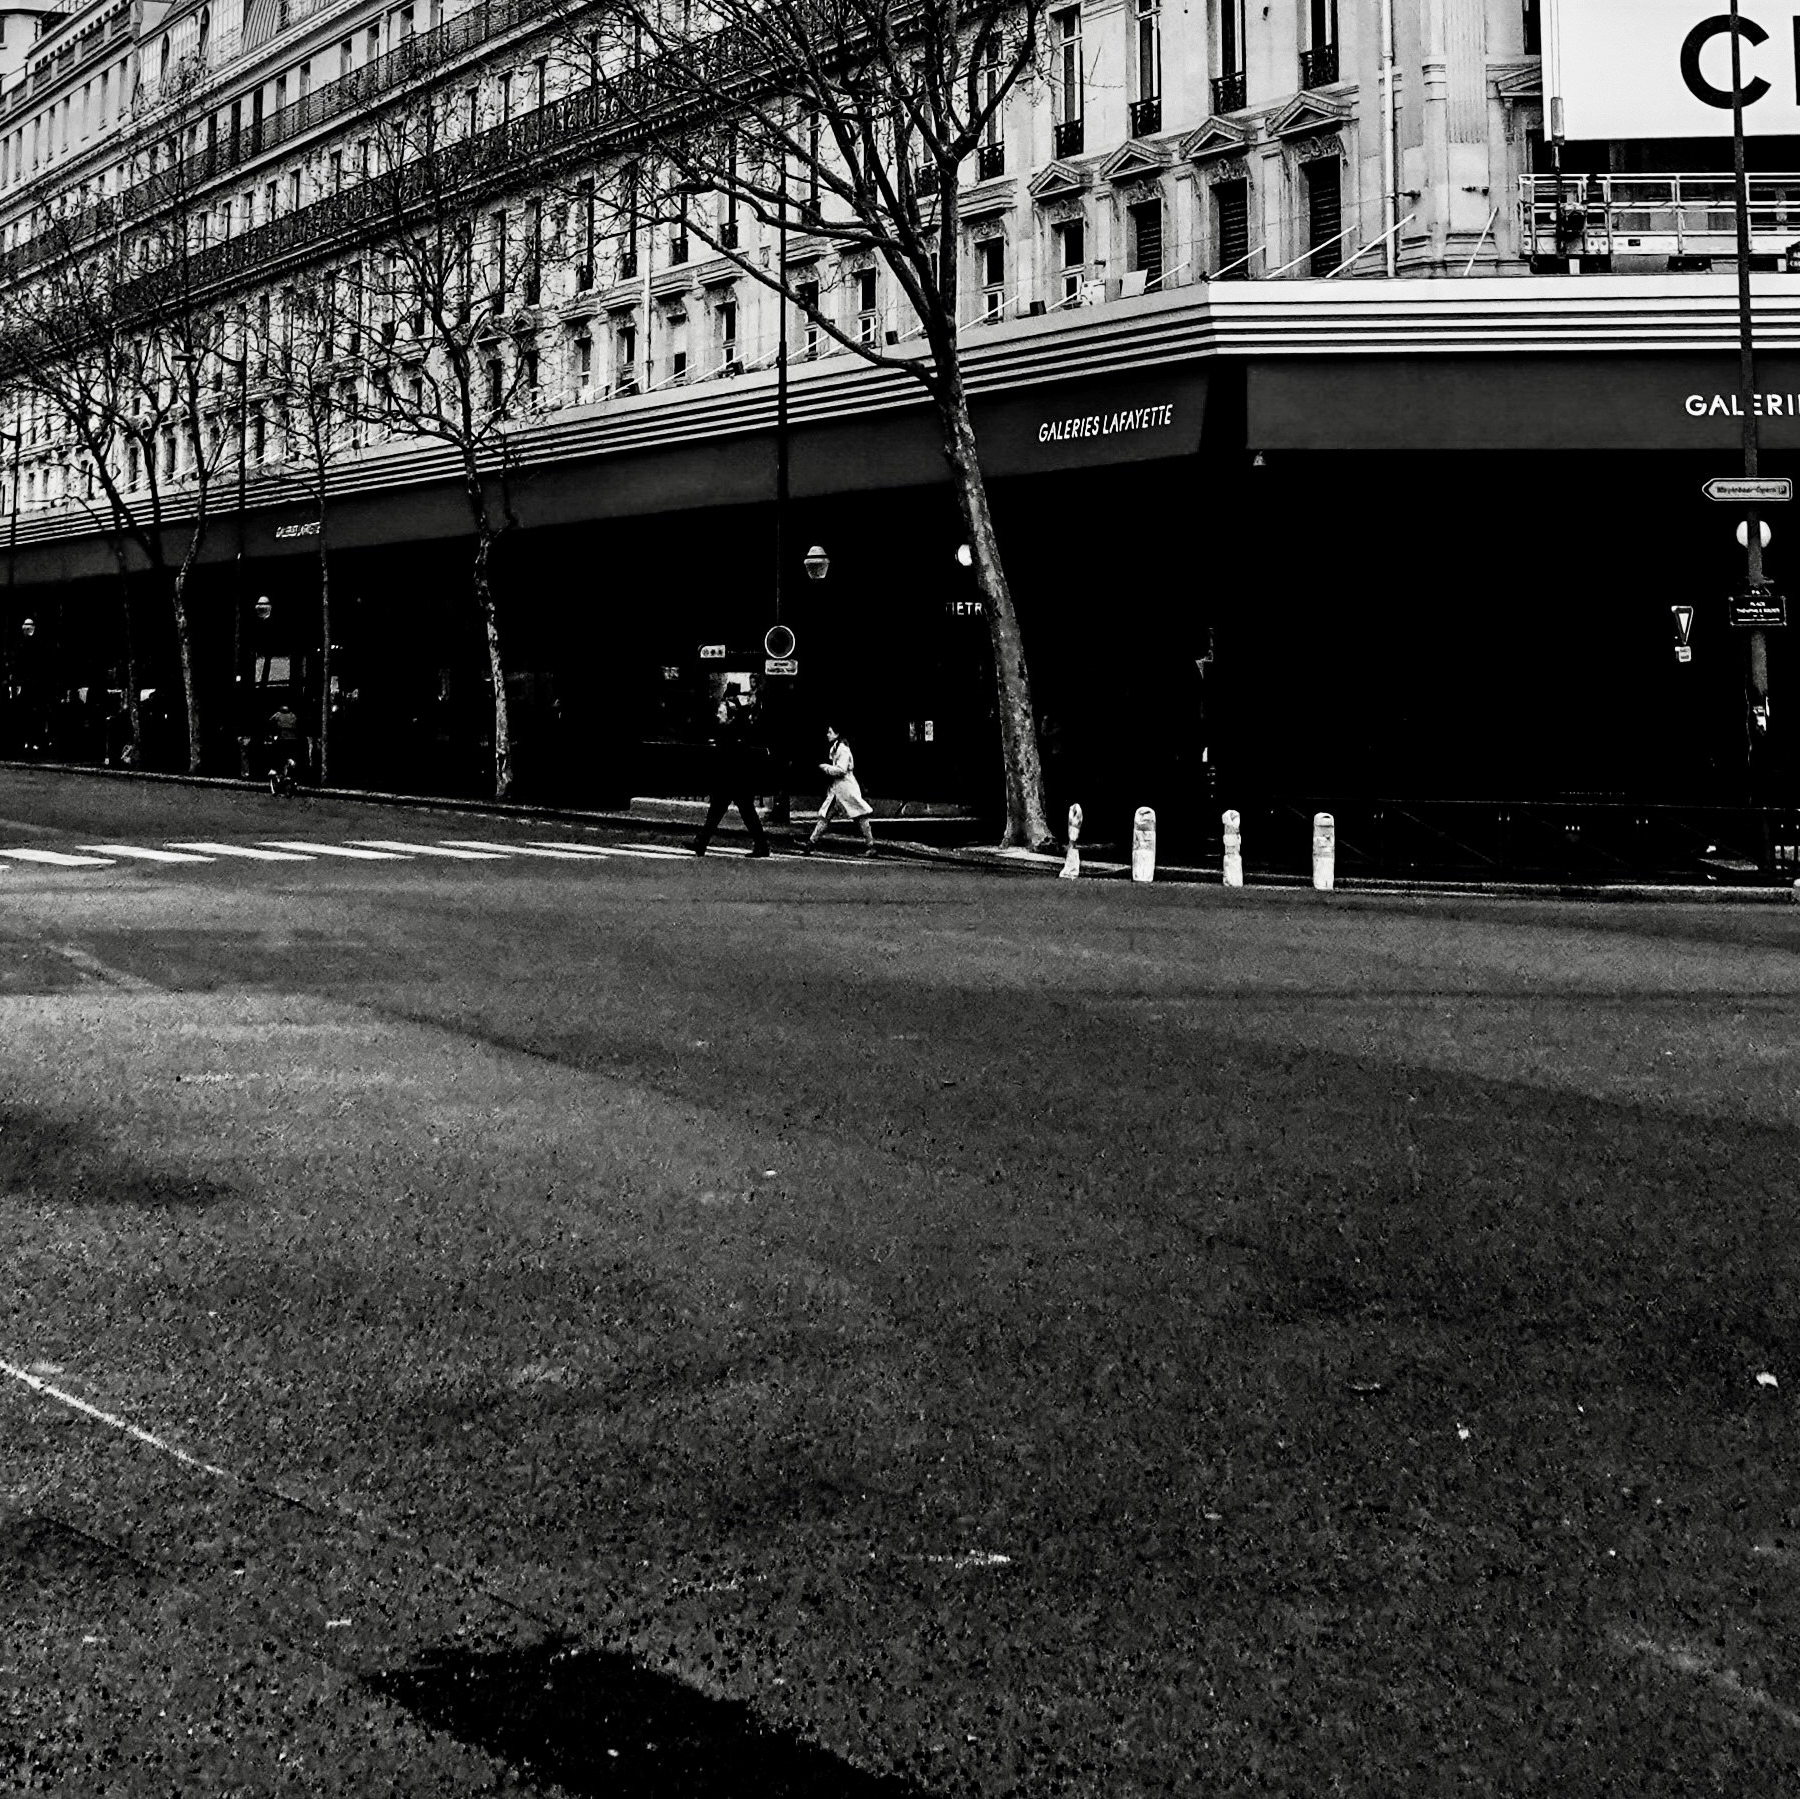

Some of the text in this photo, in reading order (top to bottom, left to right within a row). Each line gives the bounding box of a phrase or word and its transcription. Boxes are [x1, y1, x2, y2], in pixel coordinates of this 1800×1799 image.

[1038, 403, 1173, 442] GALERIES LAFAYETTE
[945, 601, 988, 616] METR
